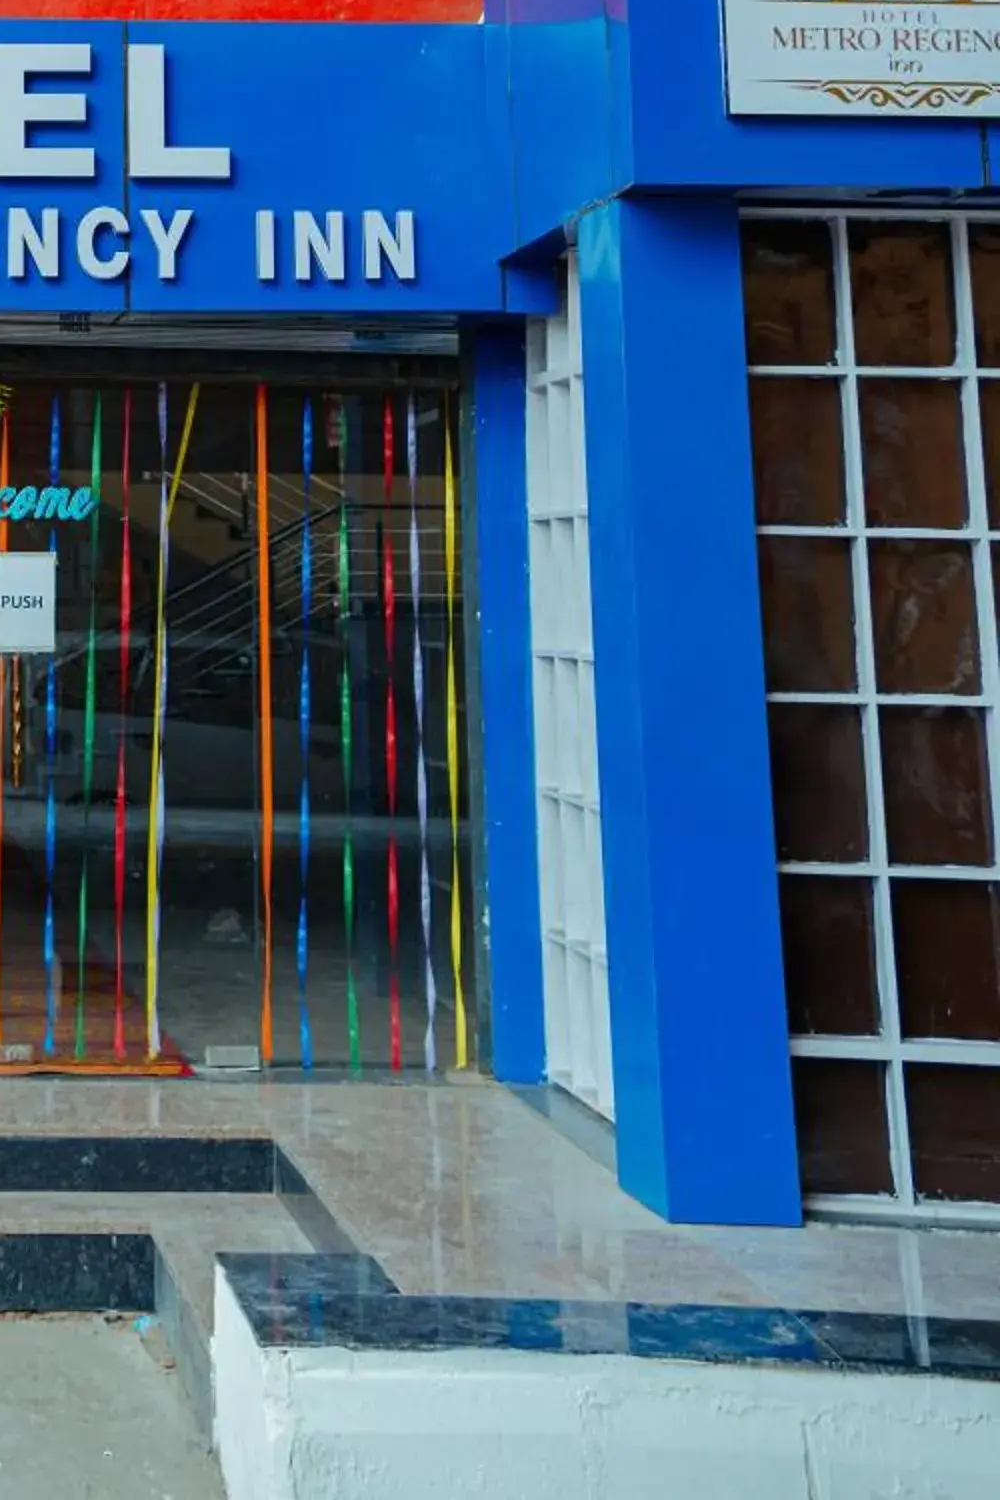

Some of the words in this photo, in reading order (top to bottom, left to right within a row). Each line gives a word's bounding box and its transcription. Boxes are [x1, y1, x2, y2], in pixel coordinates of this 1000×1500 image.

[862, 9, 941, 25] HOTEL
[772, 26, 881, 51] METRO
[255, 210, 417, 281] INN
[0, 595, 43, 609] PUSH
